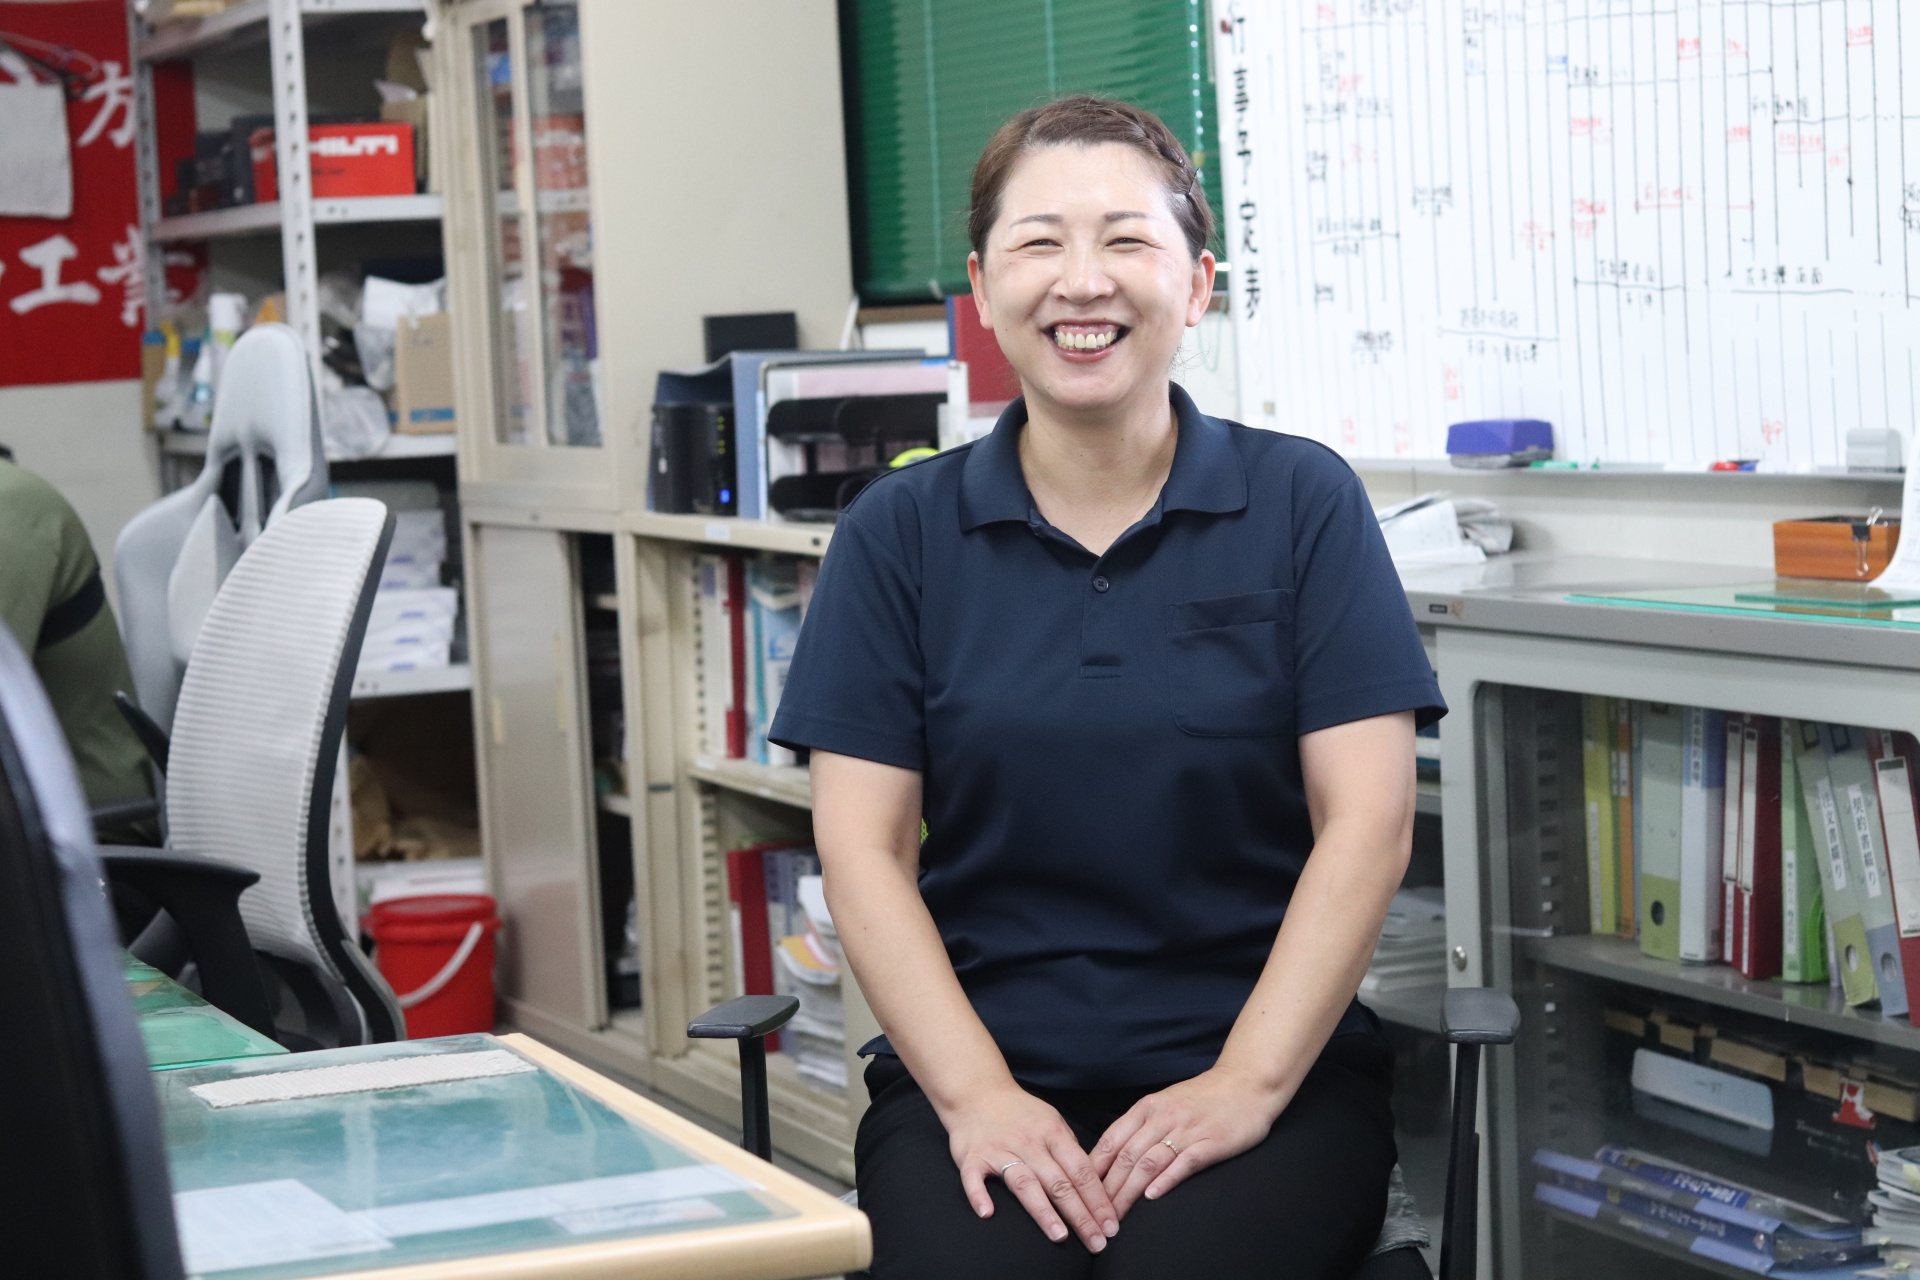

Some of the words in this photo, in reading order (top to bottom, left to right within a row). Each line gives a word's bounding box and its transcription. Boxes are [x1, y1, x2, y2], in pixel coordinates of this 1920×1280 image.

[1821, 791, 1843, 879] 注文書綴り
[1852, 797, 1877, 886] 契約書綴り
